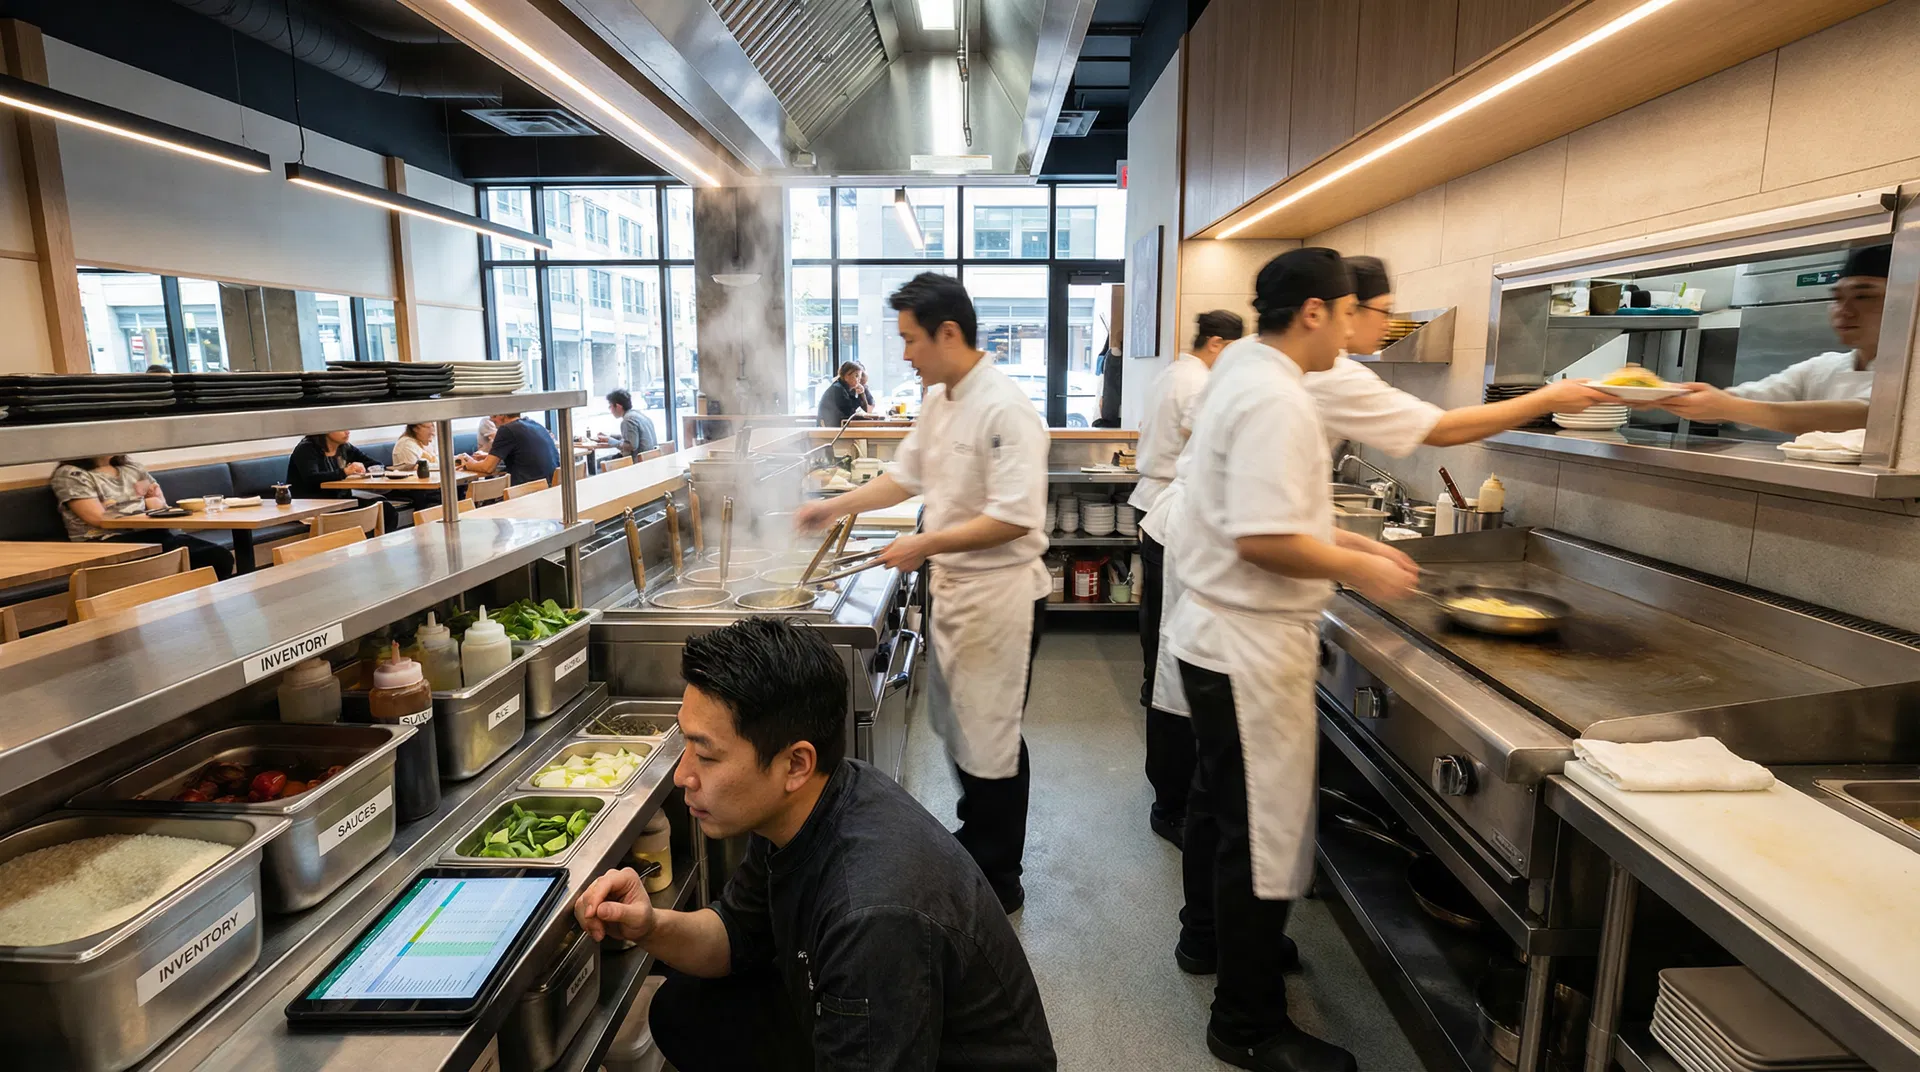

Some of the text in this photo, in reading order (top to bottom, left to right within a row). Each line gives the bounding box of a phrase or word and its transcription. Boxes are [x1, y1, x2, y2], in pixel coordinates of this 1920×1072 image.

[261, 633, 328, 672] INVENTORY
[337, 802, 377, 837] SAUCES
[159, 912, 239, 983] INVENTORY
